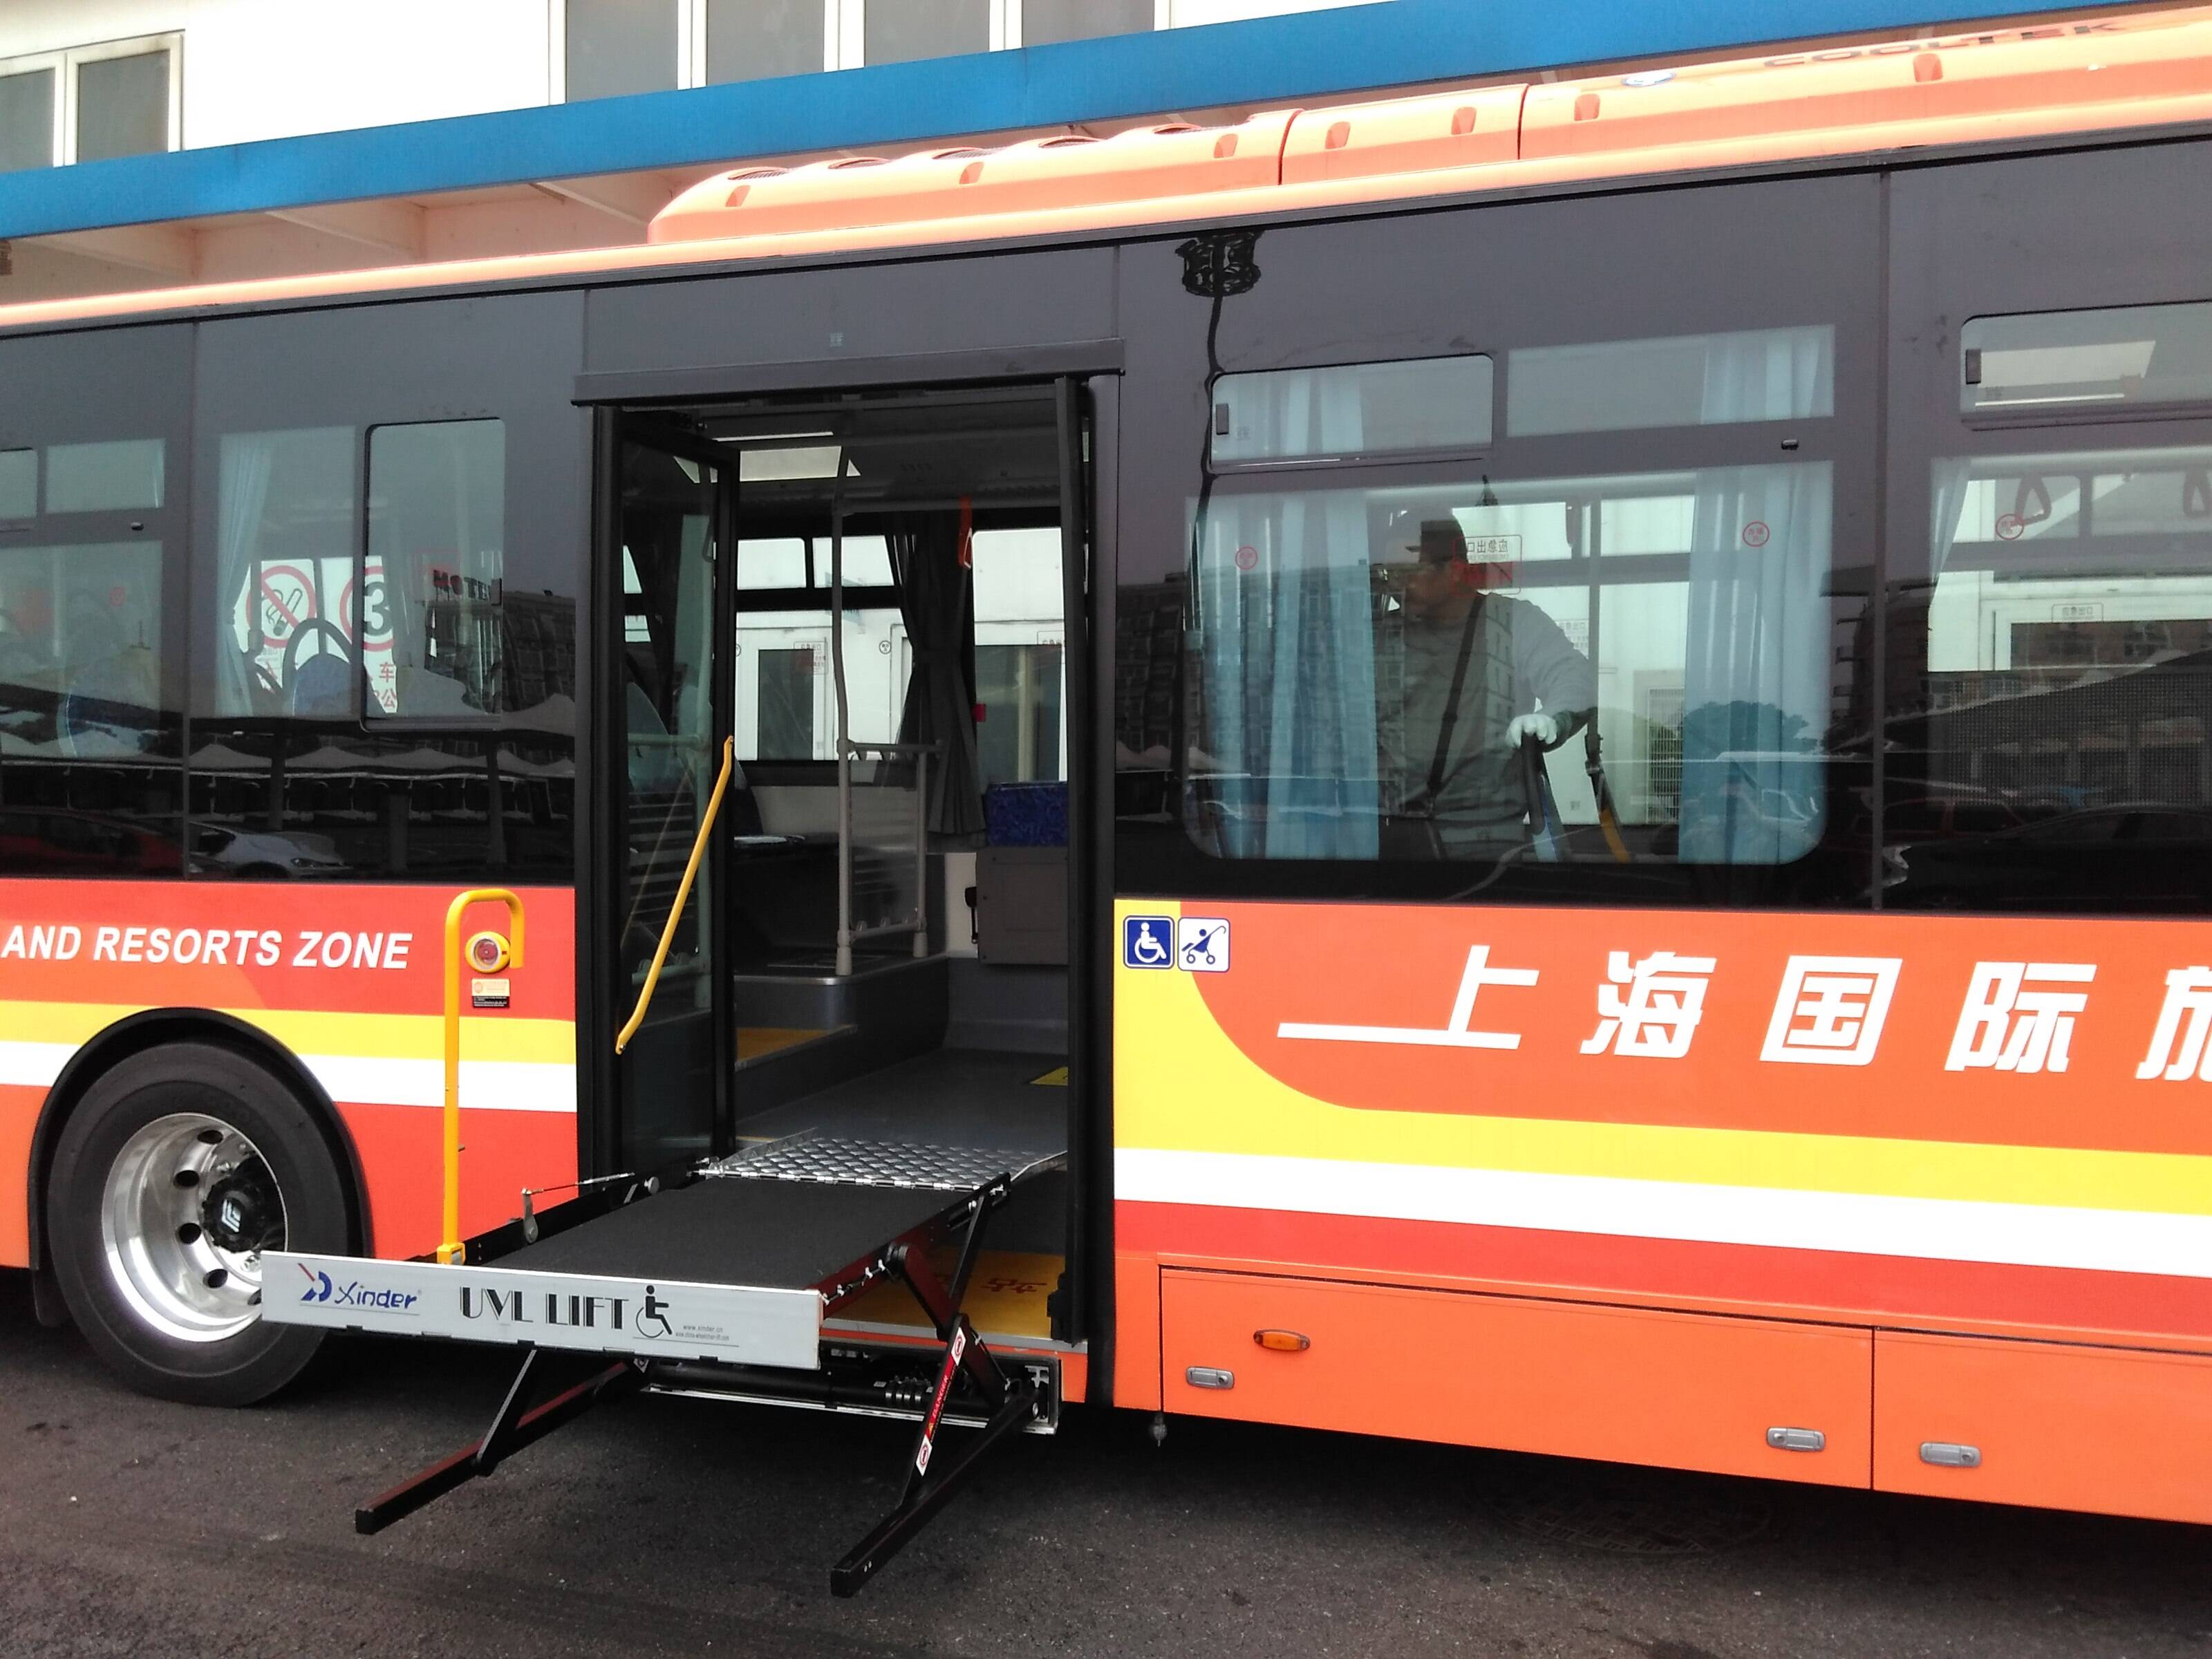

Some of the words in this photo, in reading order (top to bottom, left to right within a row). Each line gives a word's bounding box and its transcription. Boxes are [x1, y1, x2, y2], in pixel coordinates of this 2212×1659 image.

[1764, 23, 2126, 68] COOLTEK
[1, 925, 81, 960] AND
[93, 926, 282, 966] RESORTS
[292, 930, 413, 968] ZONE
[334, 1281, 418, 1309] Xinder
[460, 1286, 534, 1323] UVL
[545, 1293, 630, 1330] LIFT
